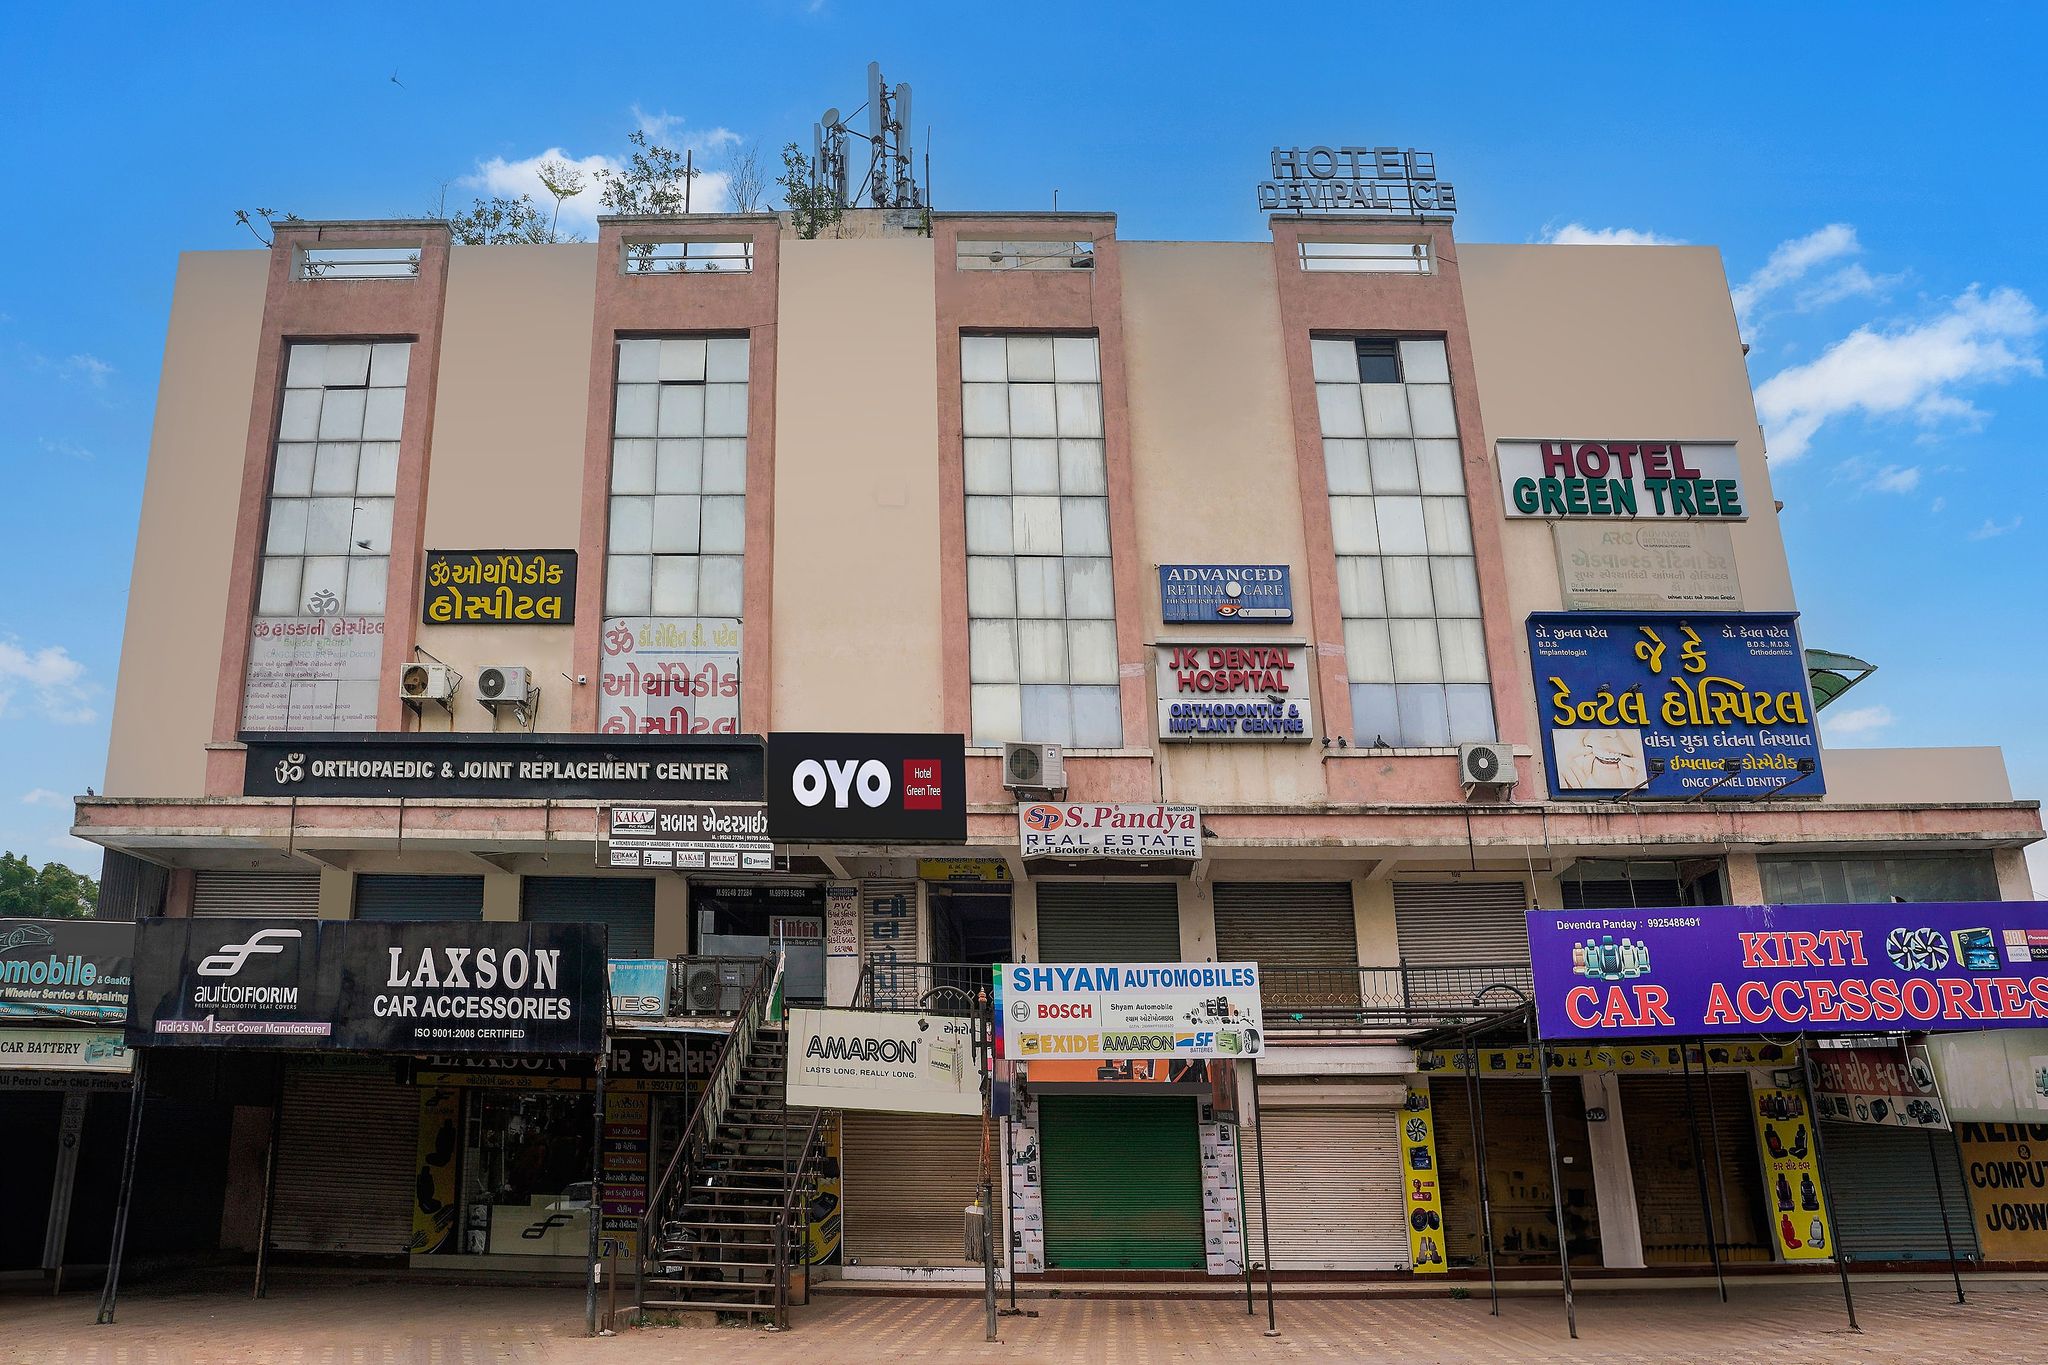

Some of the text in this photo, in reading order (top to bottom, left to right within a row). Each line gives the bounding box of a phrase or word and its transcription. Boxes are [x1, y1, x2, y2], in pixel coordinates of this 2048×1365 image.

[1273, 146, 1436, 181] HOTEL
[1540, 442, 1701, 479] HOTEL
[1513, 477, 1742, 515] GREEN TREE
[452, 555, 564, 584] ઓર્થોપેડીક
[1168, 568, 1283, 582] ADVANCED
[1167, 584, 1284, 596] RETINA CARE
[429, 585, 562, 622] હોસ્પીટલ
[272, 618, 325, 637] હાડકાની
[1585, 625, 1609, 638] પટેલ
[1740, 625, 1764, 638] કેવલ
[1766, 625, 1790, 638] પટેલ
[1539, 649, 1588, 658] Implantologist
[1635, 625, 1708, 673] જે કે
[1169, 647, 1295, 669] JK DENTAL
[603, 662, 738, 697] ઓર્થોપેડીક
[1177, 670, 1289, 693] HOSPITAL
[1549, 676, 1808, 727] ડેન્ટલ હોસ્પિટલ
[1170, 703, 1300, 718] ORTHODONTIC &
[1169, 718, 1304, 733] IMPLANT CENTRE
[1644, 729, 1812, 754] વાંકા ચુકા દાંતના નિષ્ણાત
[311, 760, 730, 781] ORTHOPAEDIC & JOINT REPLACEMENT CENTER
[914, 767, 932, 779] Hotel
[792, 759, 891, 808] OYO
[906, 785, 941, 796] Green Tree
[1682, 777, 1787, 788] ONGC PANEL DENTIST
[616, 810, 646, 823] KAKA
[1064, 806, 1196, 835] S.Pandya
[1026, 834, 1195, 847] REAL ESTATE
[1026, 846, 1052, 855] Land
[1055, 846, 1090, 855] Broker
[1103, 847, 1137, 855] Estate
[1139, 847, 1196, 857] Consultant
[833, 902, 852, 910] PVC
[1556, 919, 1601, 931] Devendra
[1602, 919, 1638, 931] Panday
[1647, 917, 1701, 929] 9925488491
[1738, 930, 1869, 968] KIRTI
[387, 947, 561, 990] LAXSON
[97, 975, 131, 986] & GasKit
[1013, 967, 1256, 992] SHYAM AUTOMOBILES
[5, 987, 130, 1005] Wheeler Service & Repairing
[1565, 977, 2048, 1029] CAR ACCESSORIES
[373, 994, 571, 1020] CAR ACCESSORIES
[1037, 1004, 1092, 1019] BOSCH
[1110, 1003, 1173, 1012] Shyam Automobile
[158, 1021, 326, 1034] India's Seat Cover Manufacturer
[414, 1028, 525, 1039] ISO 9001:2008 CERTIFIED
[1, 1041, 81, 1054] CAR BATTERY
[1040, 1033, 1100, 1054] EXIDE
[1103, 1034, 1175, 1051] AMARON
[1194, 1032, 1214, 1047] SF
[806, 1035, 917, 1064] AMARON
[805, 1066, 831, 1074] LASTS
[860, 1069, 889, 1077] REALLY
[13, 1075, 41, 1086] Petrol
[70, 1078, 90, 1088] CNG
[1773, 1158, 1811, 1171] કાર સીટ કવર
[1970, 1161, 2048, 1189] COMPU
[1986, 1203, 2048, 1232] JOBW
